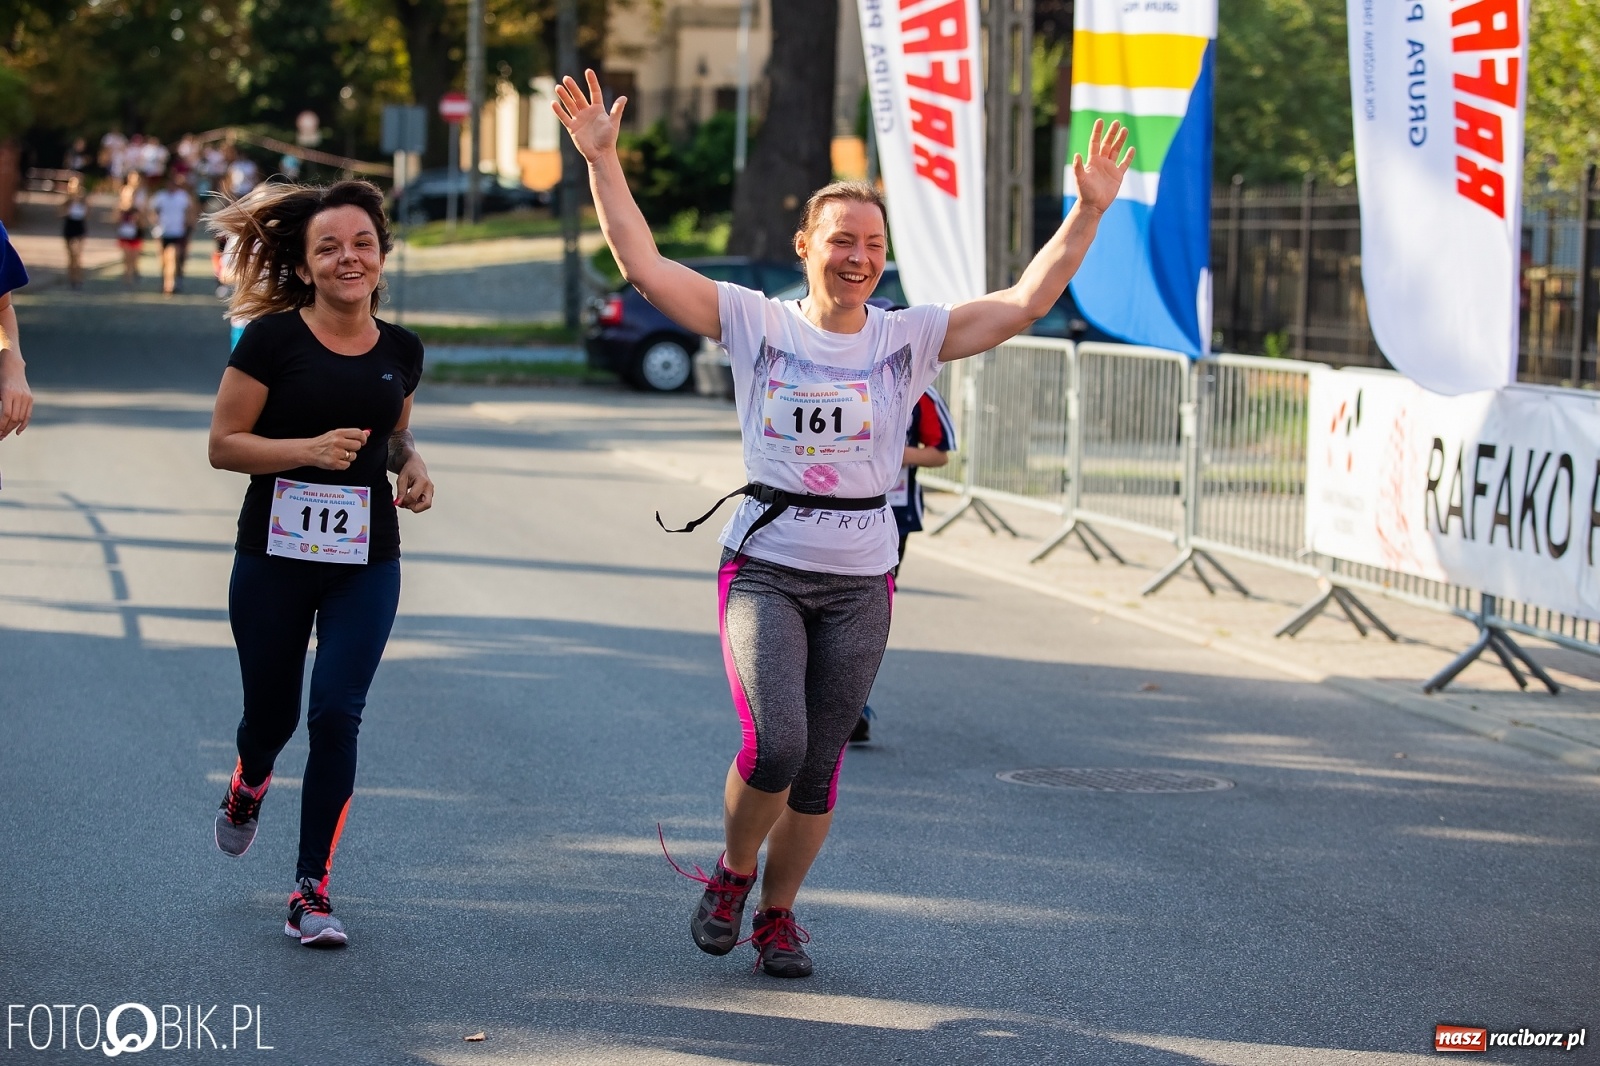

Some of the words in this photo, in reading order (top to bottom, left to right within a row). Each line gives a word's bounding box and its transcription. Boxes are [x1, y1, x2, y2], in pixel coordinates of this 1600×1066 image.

[792, 406, 842, 434] 161
[1425, 437, 1574, 559] RAFAKO
[301, 505, 349, 534] 112
